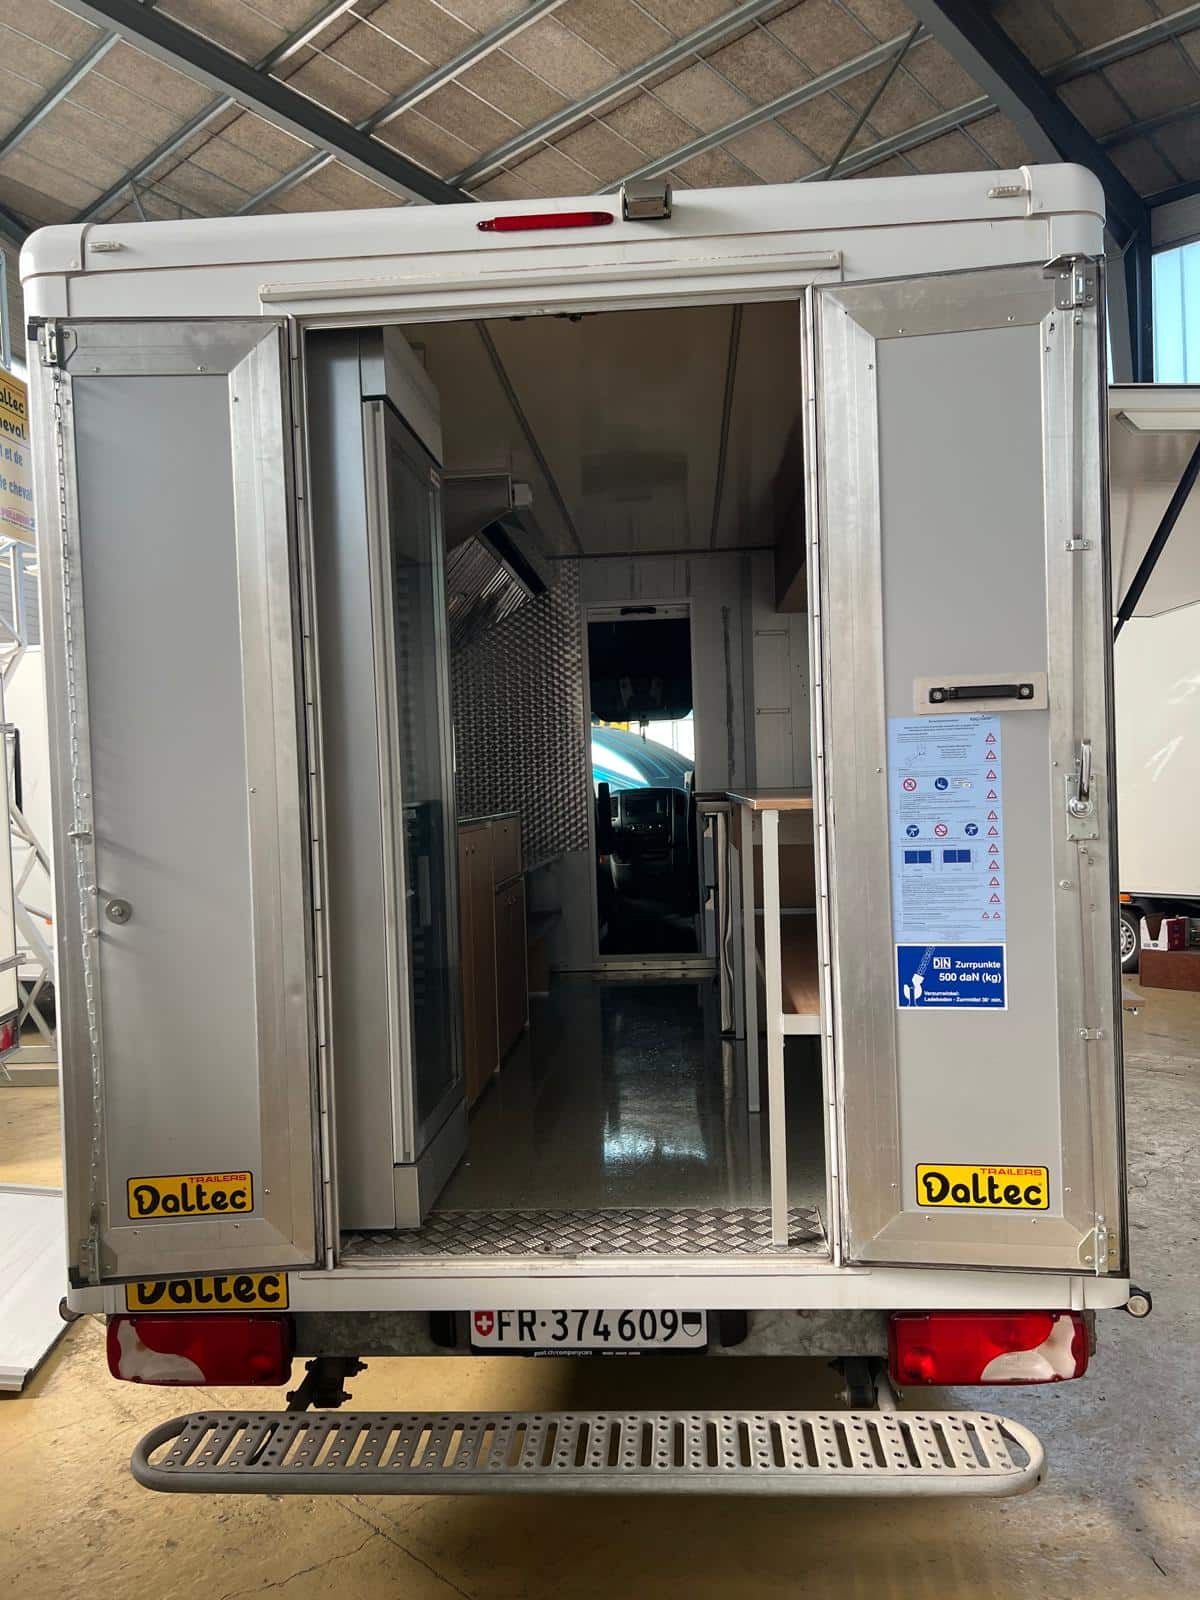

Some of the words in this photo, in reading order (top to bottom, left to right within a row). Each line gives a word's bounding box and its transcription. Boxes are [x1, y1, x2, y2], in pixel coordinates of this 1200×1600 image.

[933, 957, 951, 969] DIN
[955, 960, 1001, 970] Zurrpunkte
[939, 972, 957, 982] 500
[959, 972, 980, 982] daN
[982, 972, 1002, 984] (kg)
[980, 1167, 1042, 1176] TRAILERS
[188, 1174, 247, 1184] TRAILERS
[922, 1171, 1042, 1206] Daltec
[133, 1182, 247, 1216] Daltec
[137, 1275, 281, 1305] Daltec
